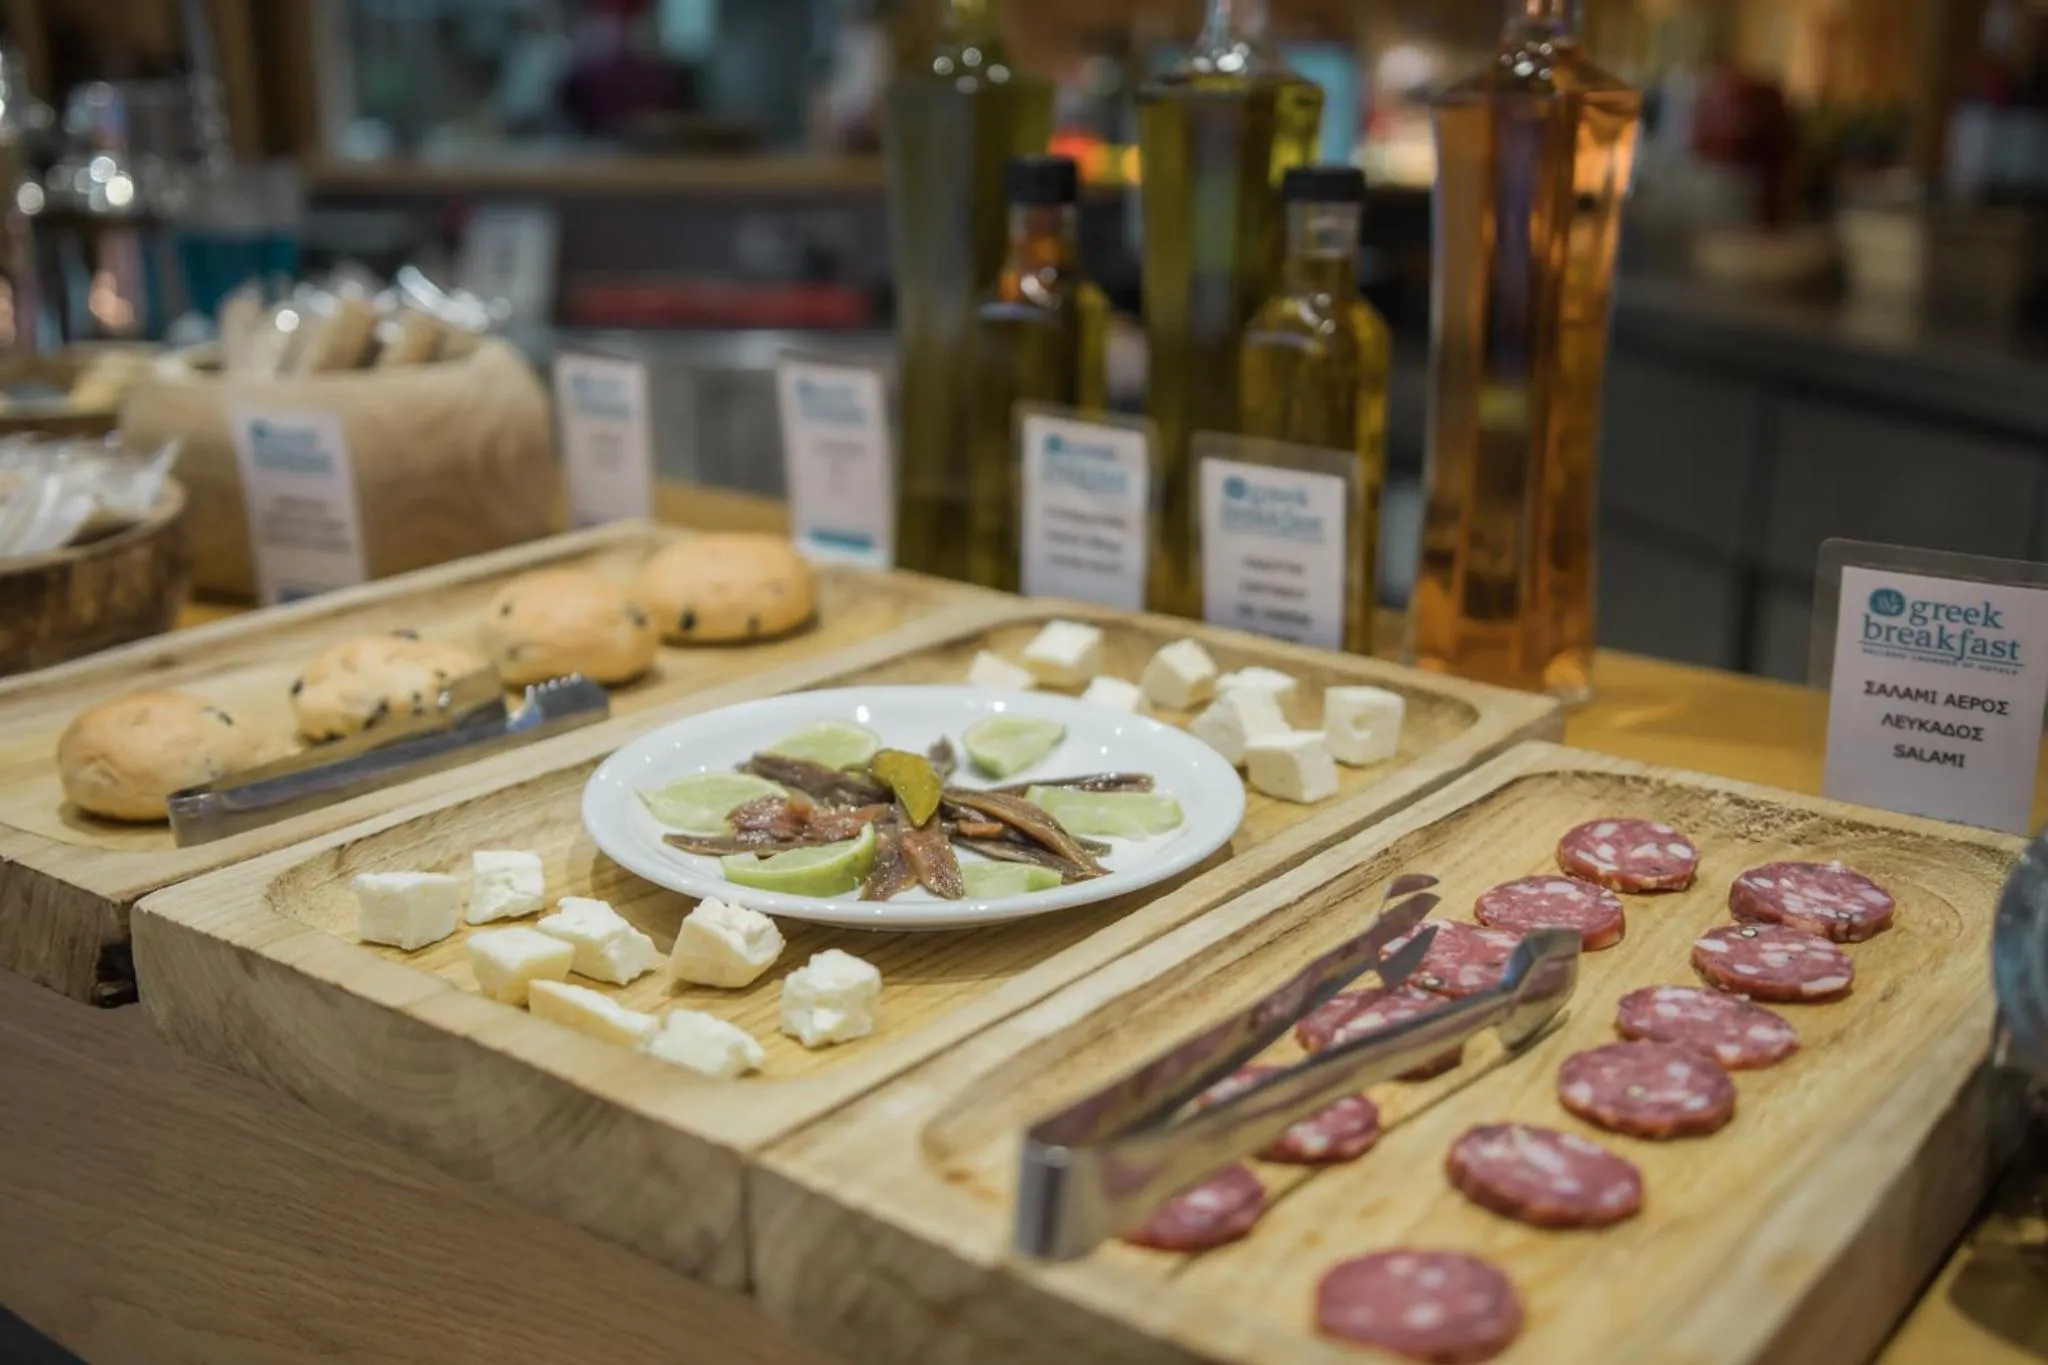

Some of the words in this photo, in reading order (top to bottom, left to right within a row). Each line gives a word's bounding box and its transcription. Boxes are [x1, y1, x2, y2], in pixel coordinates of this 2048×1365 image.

[1909, 600, 2004, 629] greek
[1862, 613, 2021, 660] breakfast
[1863, 680, 1939, 705] ΣΑΛΑΜΙ
[1944, 693, 2010, 716] ΑΕΡΟΣ
[1881, 713, 1985, 741] ΛΕΥΚΑΔΟΣ
[1893, 744, 1966, 768] SALAMI
